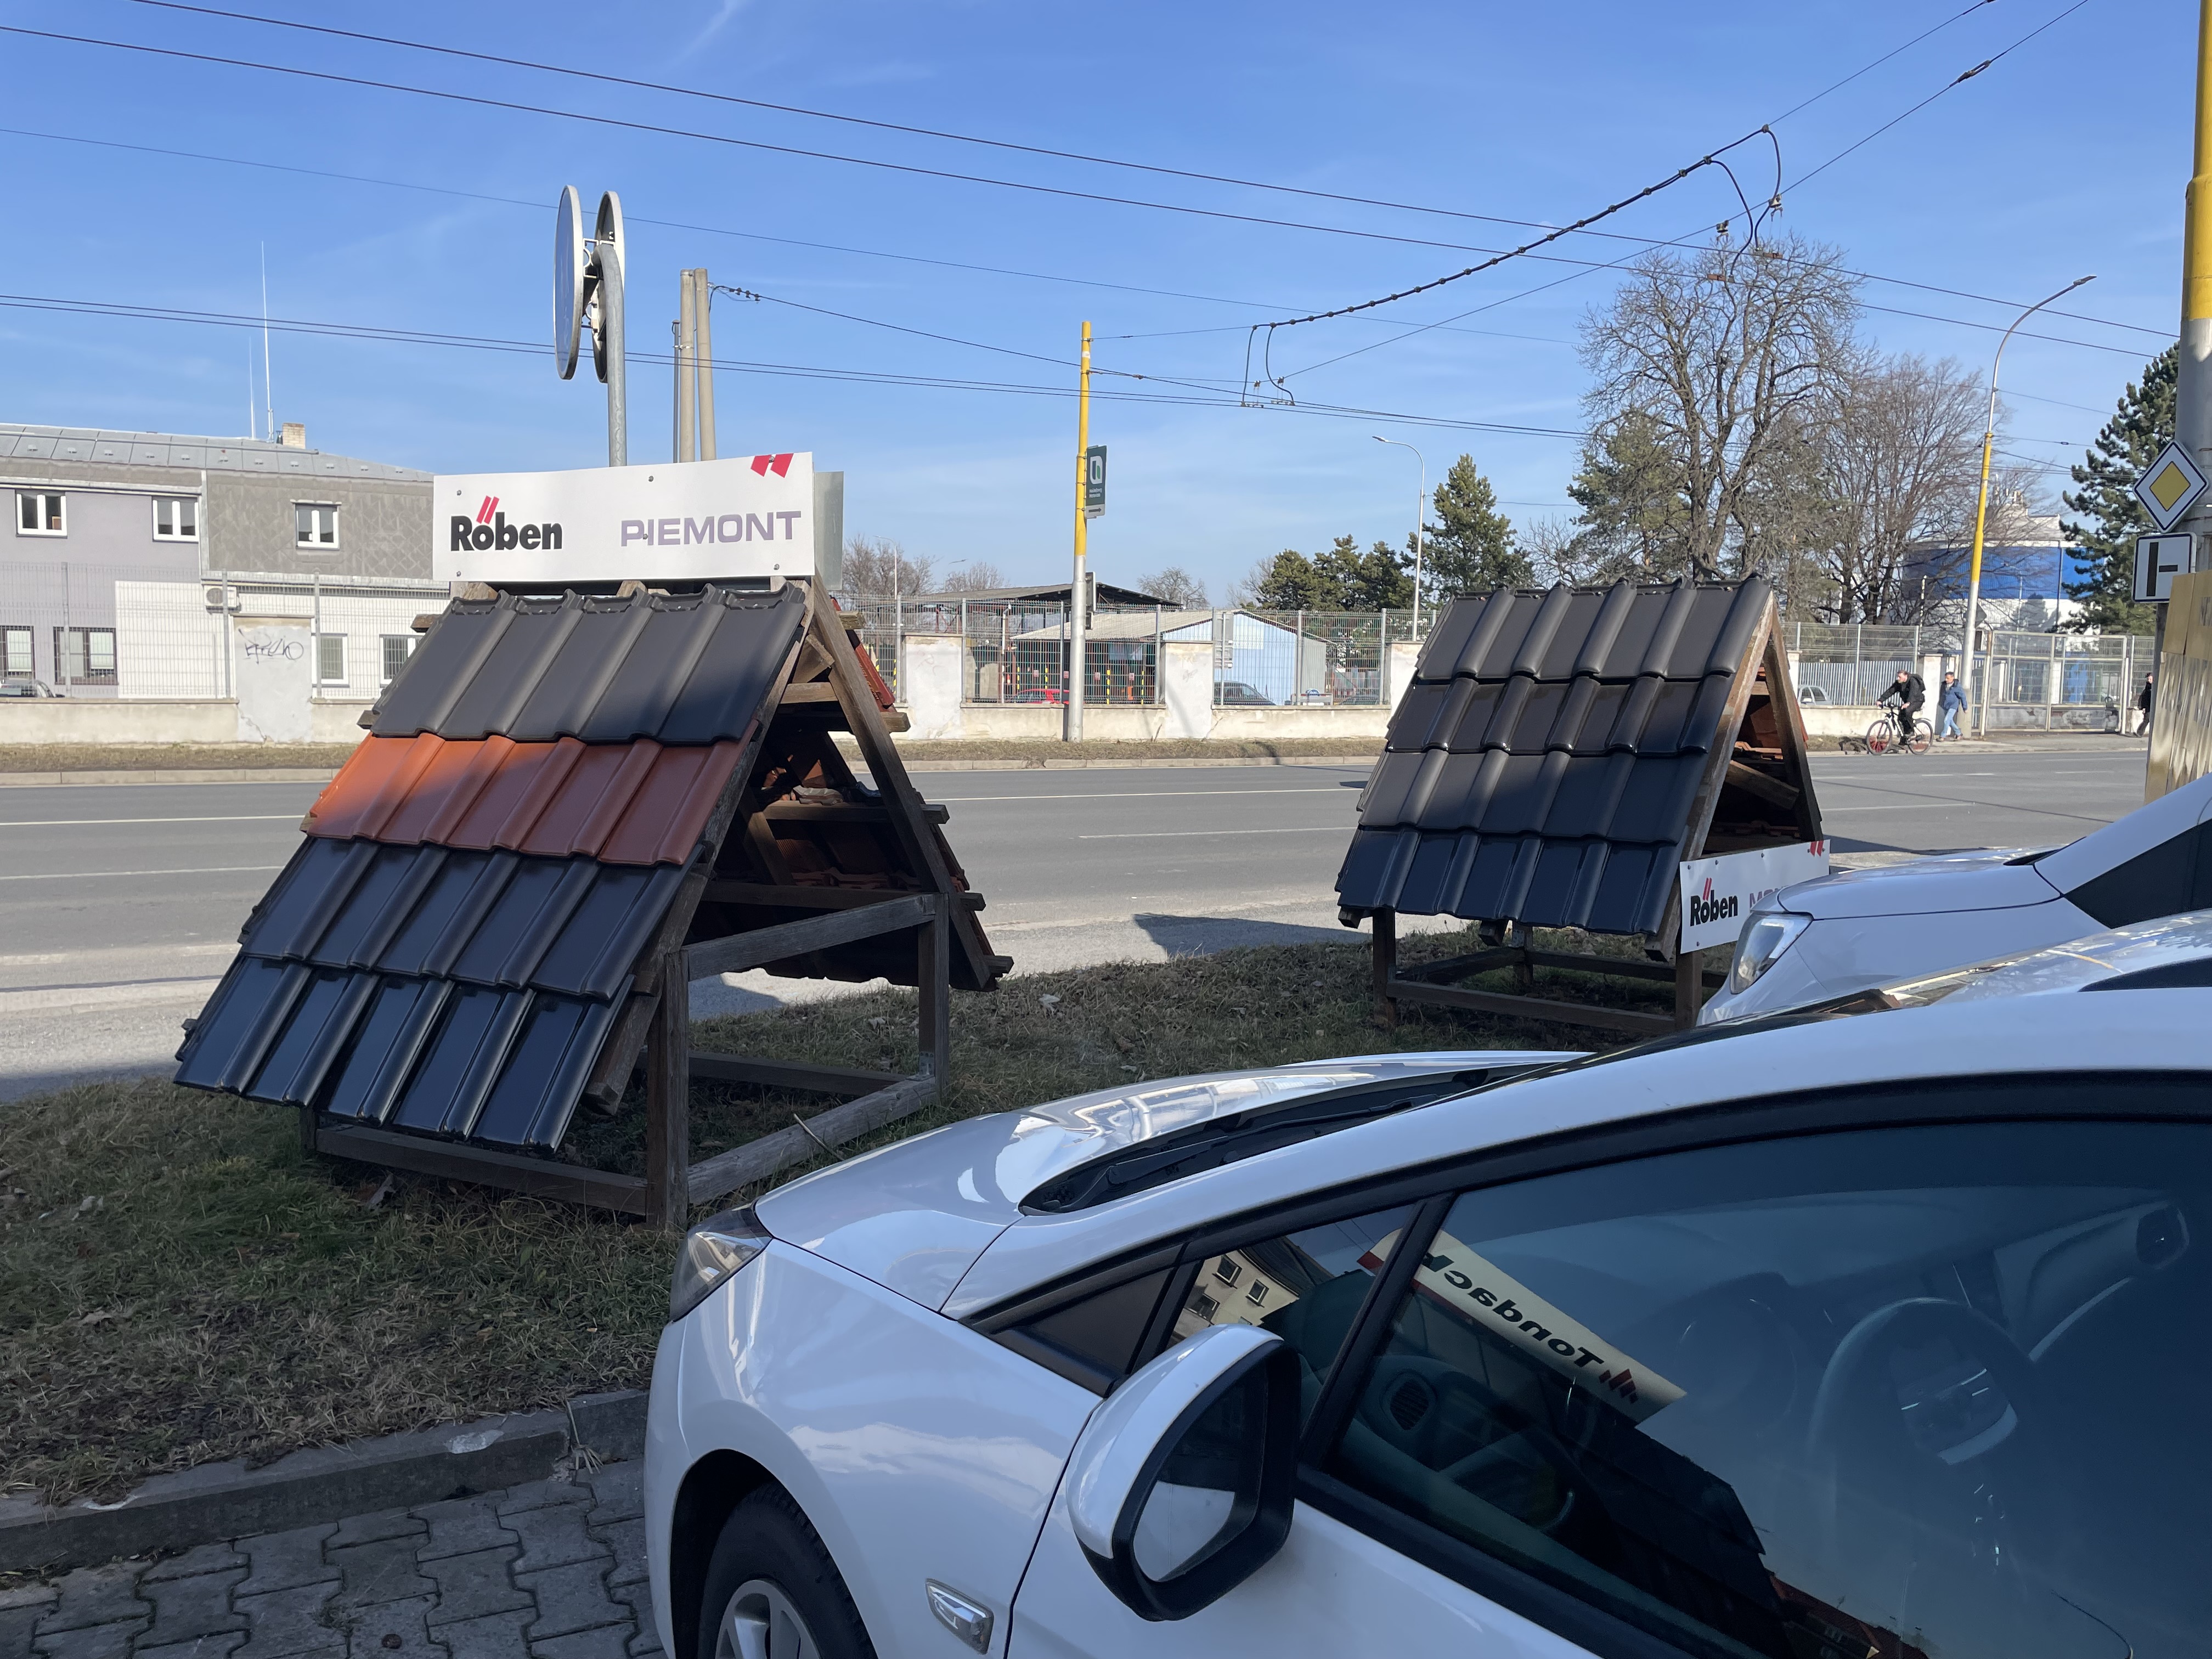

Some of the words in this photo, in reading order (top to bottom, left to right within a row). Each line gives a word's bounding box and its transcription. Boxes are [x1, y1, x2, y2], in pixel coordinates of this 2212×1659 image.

[451, 495, 562, 551] Röben
[621, 511, 802, 546] PIEMONT
[1690, 877, 1738, 927] Röben
